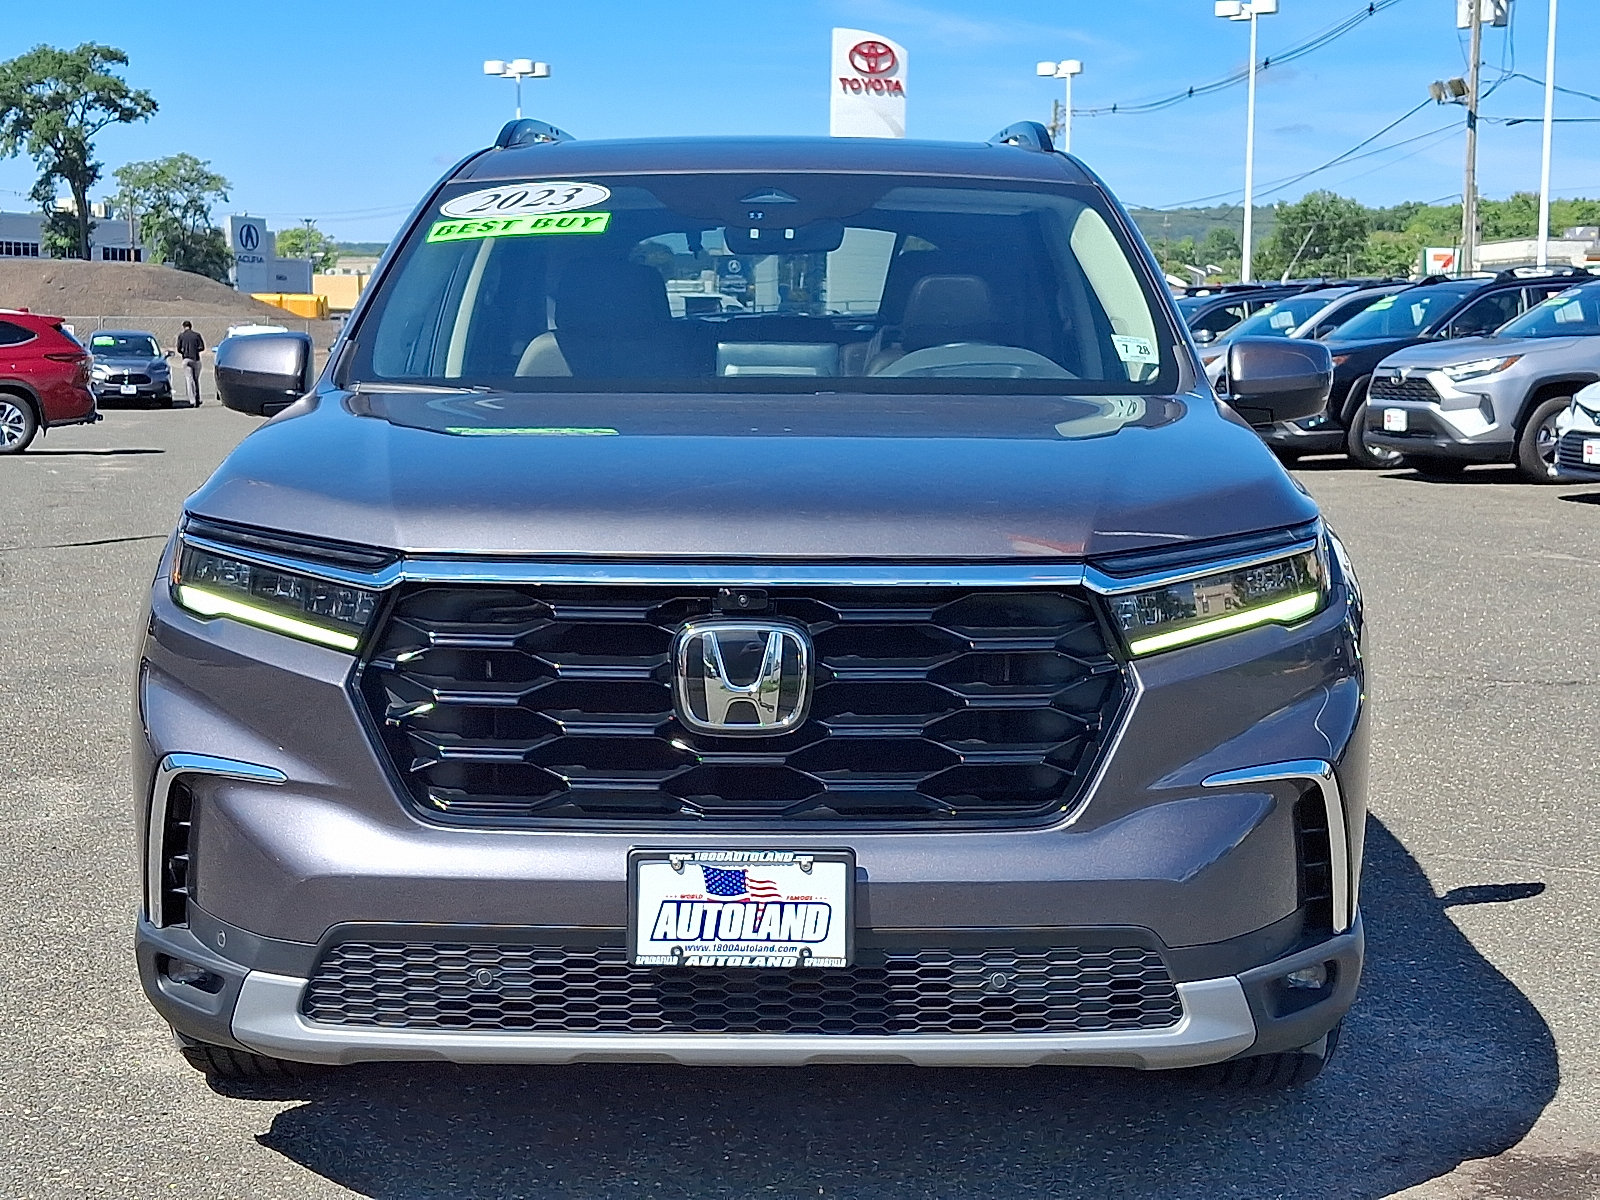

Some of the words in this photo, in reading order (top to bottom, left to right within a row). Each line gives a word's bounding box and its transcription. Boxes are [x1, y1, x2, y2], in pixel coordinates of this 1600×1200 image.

[838, 77, 904, 94] TOYOTA
[466, 187, 583, 213] 2023
[433, 219, 523, 236] BEST
[530, 216, 604, 229] BUY
[238, 255, 264, 263] ACURA
[650, 900, 832, 942] AUTOLAND
[684, 944, 798, 953] www.1800Autoland.com
[684, 955, 798, 967] AUTOLAND
